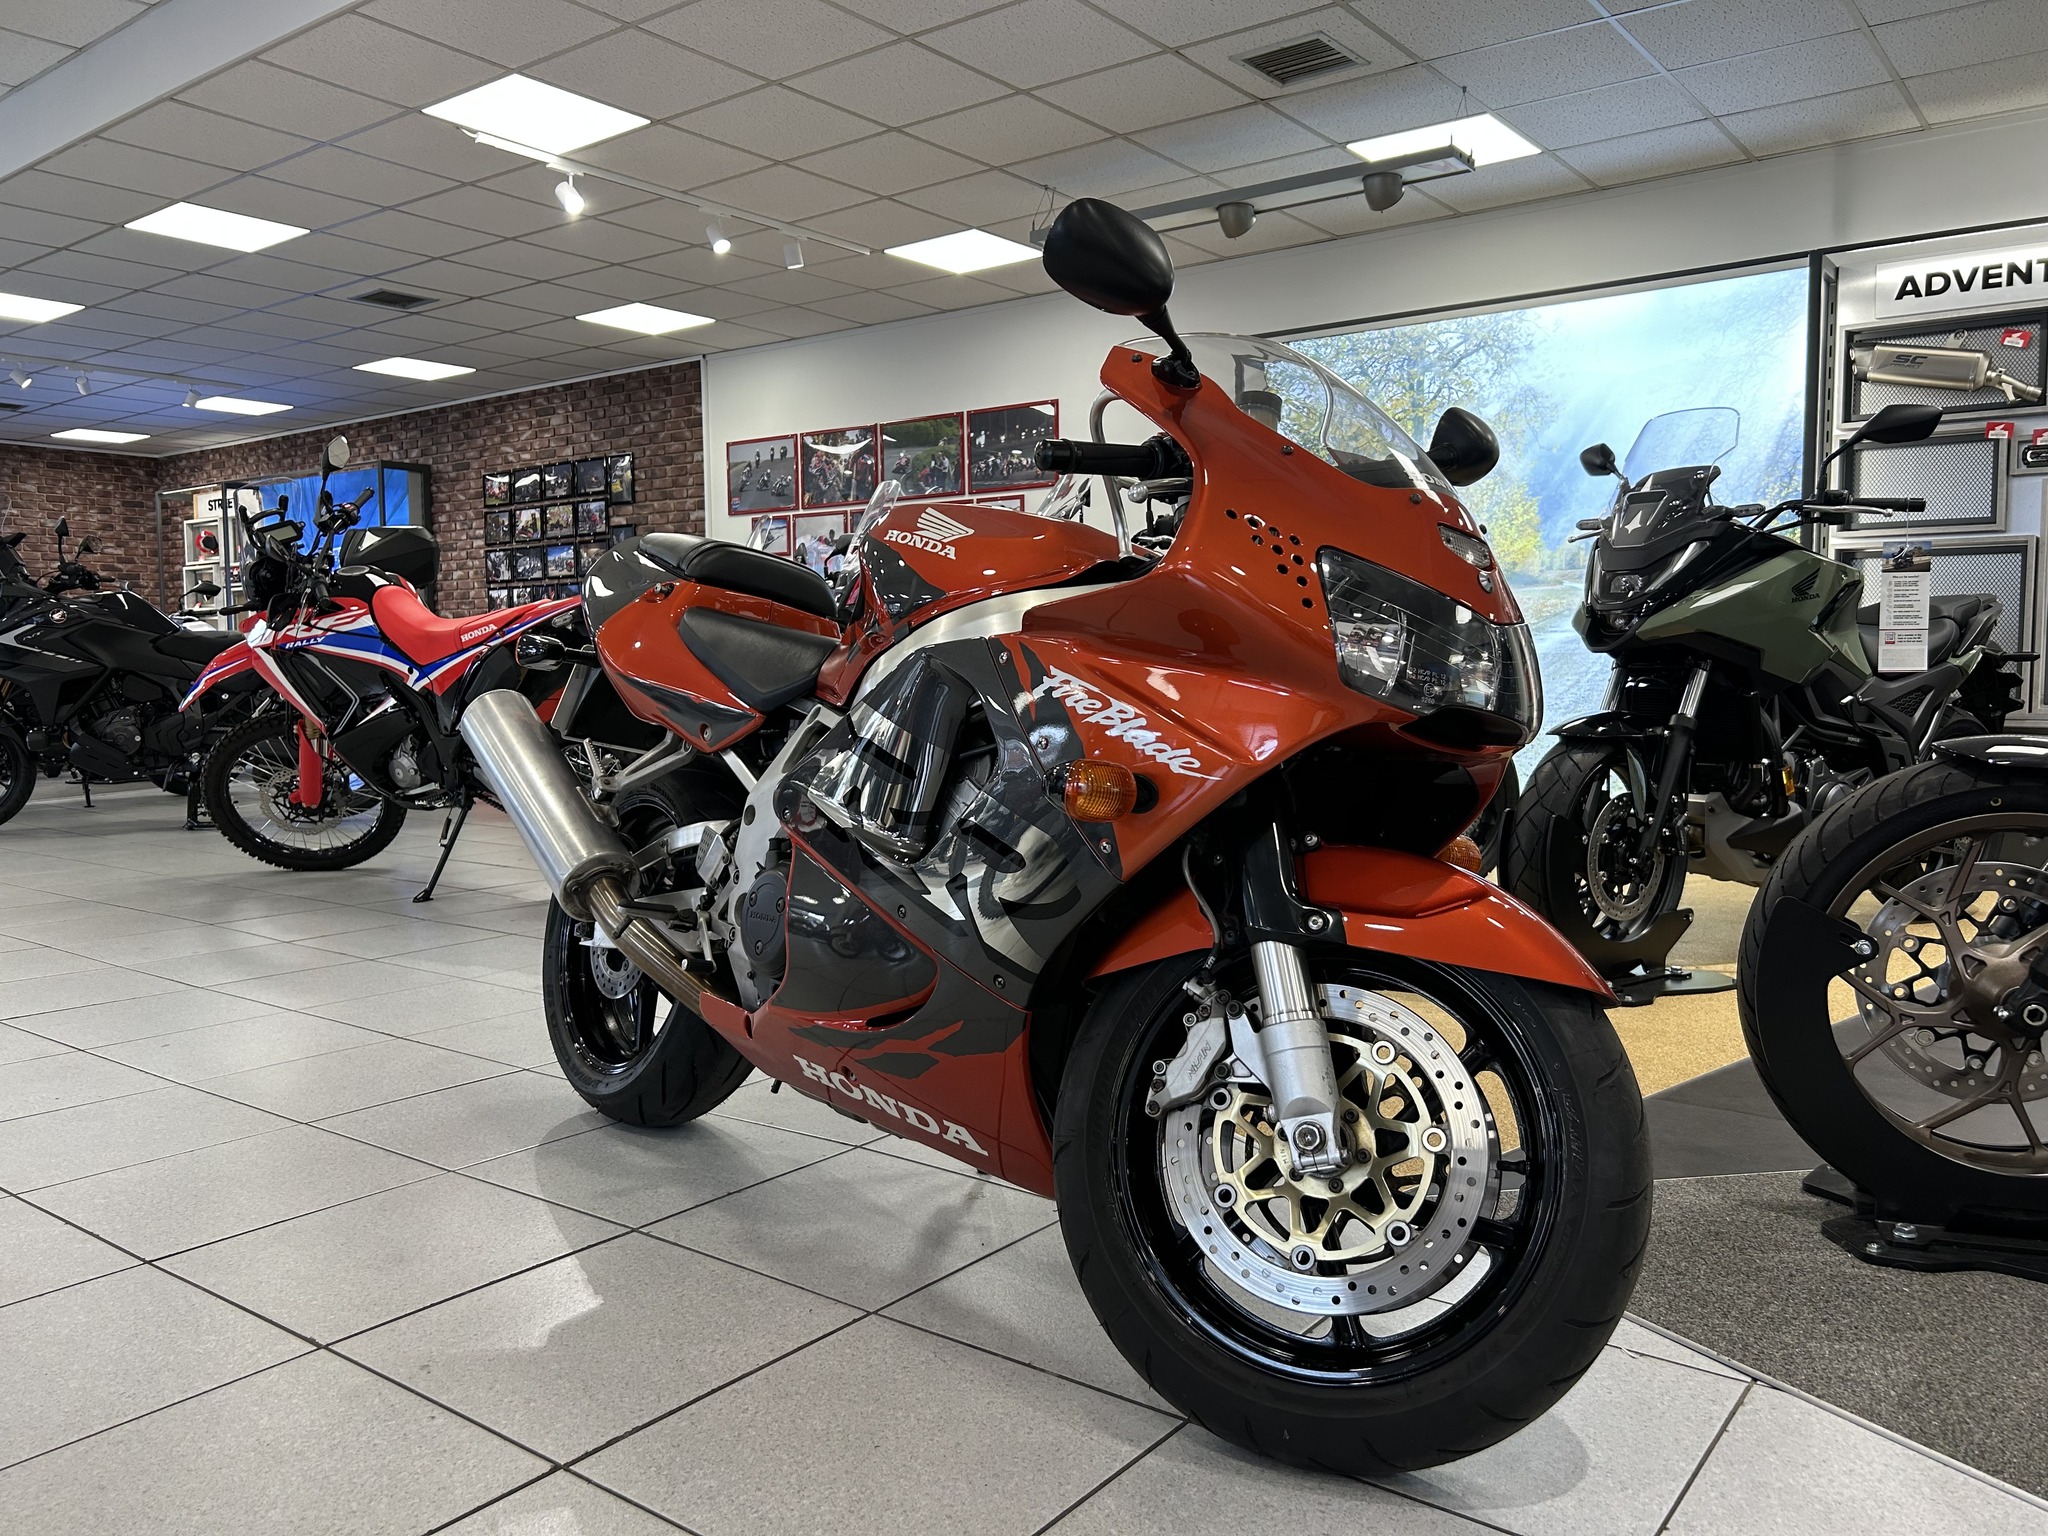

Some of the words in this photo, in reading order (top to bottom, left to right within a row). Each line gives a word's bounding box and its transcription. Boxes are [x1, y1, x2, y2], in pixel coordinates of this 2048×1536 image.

[1892, 354, 1928, 364] SC
[883, 529, 957, 560] HONDA
[1791, 593, 1820, 603] HONDA
[460, 623, 498, 642] HONDA
[285, 636, 326, 649] RALLY
[792, 1054, 989, 1157] HONDA
